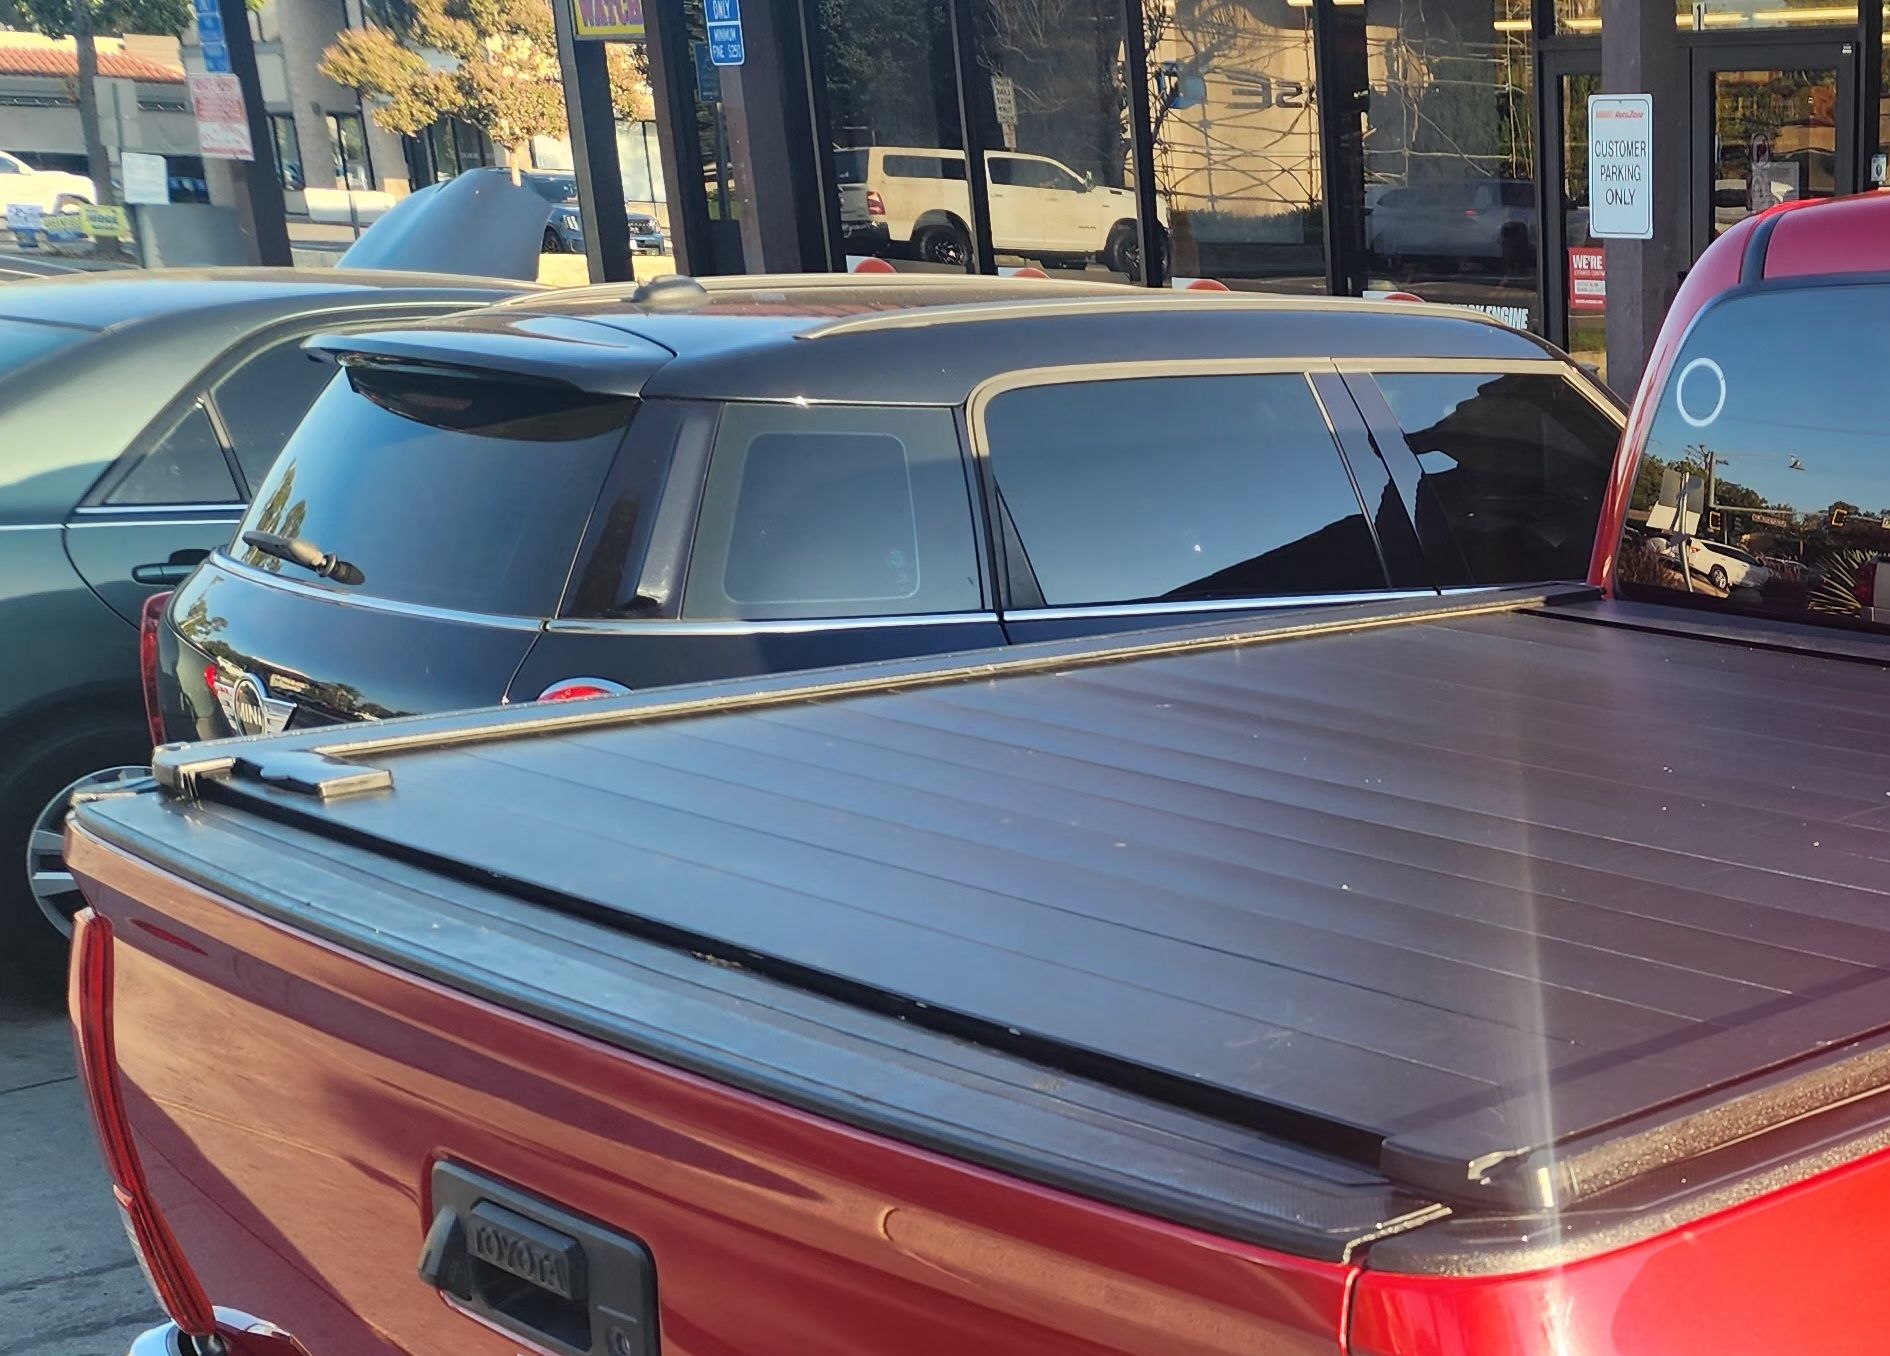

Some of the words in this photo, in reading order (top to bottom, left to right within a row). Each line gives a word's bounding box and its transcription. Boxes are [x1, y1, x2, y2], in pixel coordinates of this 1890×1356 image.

[712, 0, 731, 19] ONLY
[1614, 110, 1644, 119] AutoZone
[1594, 140, 1647, 158] CUSTOMER
[1600, 164, 1641, 183] PARKING
[1605, 188, 1636, 206] ONLY
[1571, 254, 1603, 270] WE'RE
[474, 1225, 571, 1297] TOYOTA
